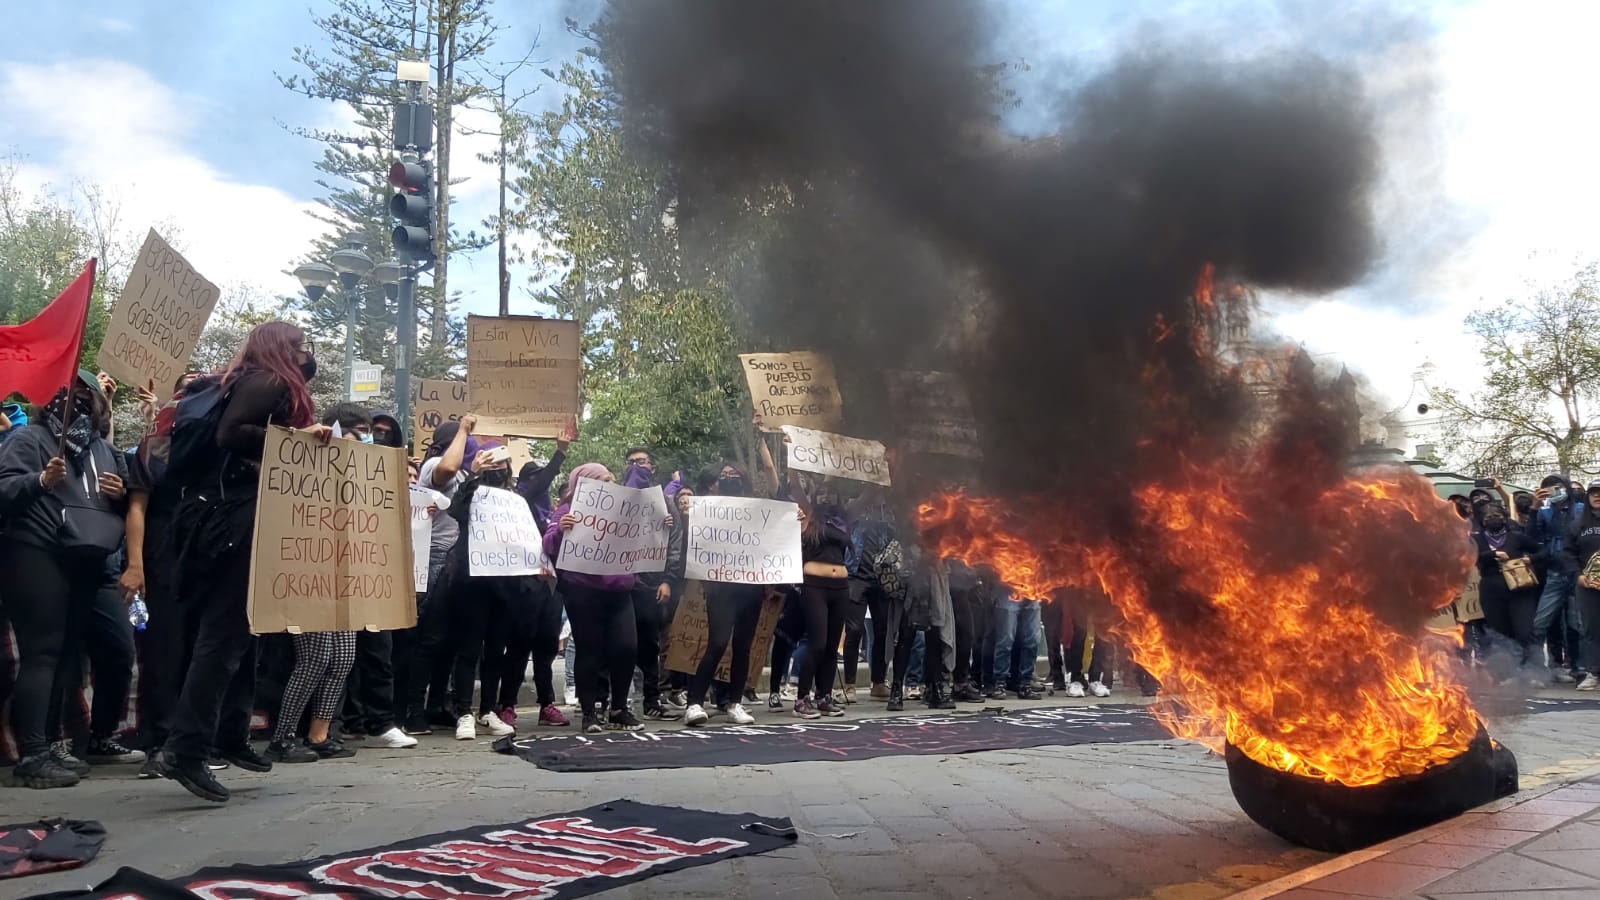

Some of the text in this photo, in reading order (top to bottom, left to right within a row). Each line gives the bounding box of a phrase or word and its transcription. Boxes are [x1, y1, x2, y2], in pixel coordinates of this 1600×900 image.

[145, 238, 211, 309] BORRERO
[140, 273, 189, 330] Y LASSO
[127, 301, 185, 359] GOBIERNO
[472, 323, 511, 342] Estar
[113, 332, 172, 383] CAREMAZO
[793, 361, 812, 371] EL
[766, 372, 811, 383] PUEBLO
[769, 384, 787, 396] QUE
[419, 381, 440, 402] La
[422, 411, 441, 428] NO
[279, 437, 386, 481] CONTRA LA
[793, 442, 881, 476] estudiar
[268, 466, 394, 509] EDUCACIÓN DE
[576, 481, 614, 511] Esto
[620, 500, 640, 518] no
[292, 502, 379, 533] MERCADO
[470, 508, 486, 522] de
[491, 512, 515, 523] este
[692, 499, 771, 529] Mirones y
[471, 526, 538, 543] la lucha
[690, 525, 760, 546] parados
[280, 537, 389, 567] ESTUDIANTES
[470, 548, 518, 567] cueste
[523, 550, 537, 567] lo
[562, 539, 616, 564] pueblo
[690, 542, 793, 569] también son
[272, 572, 393, 601] ORGANIZADOS
[707, 564, 783, 583] afectados
